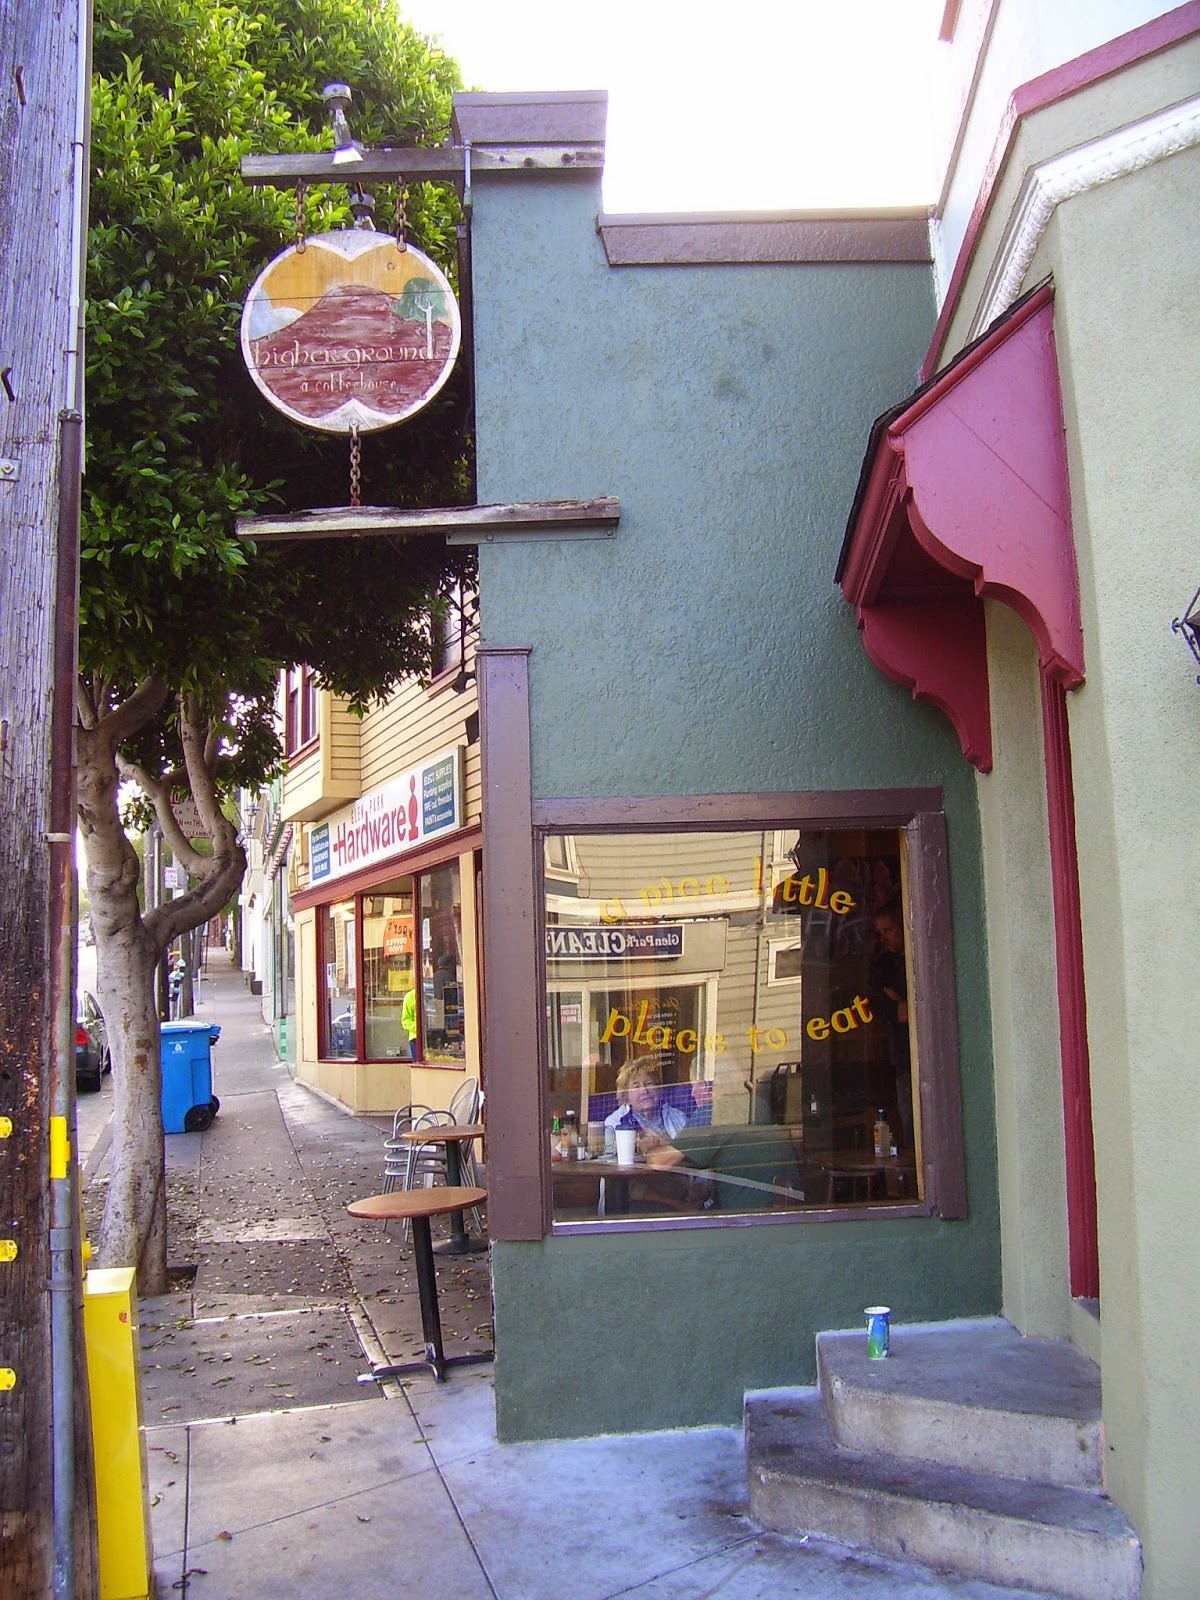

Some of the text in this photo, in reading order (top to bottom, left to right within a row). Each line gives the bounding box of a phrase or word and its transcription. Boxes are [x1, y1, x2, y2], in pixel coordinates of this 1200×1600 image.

[301, 379, 309, 392] a
[334, 805, 407, 867] Hardware
[599, 856, 857, 923] a nice lttle
[599, 999, 727, 1055] place
[745, 1023, 789, 1055] to
[806, 994, 874, 1042] eat
